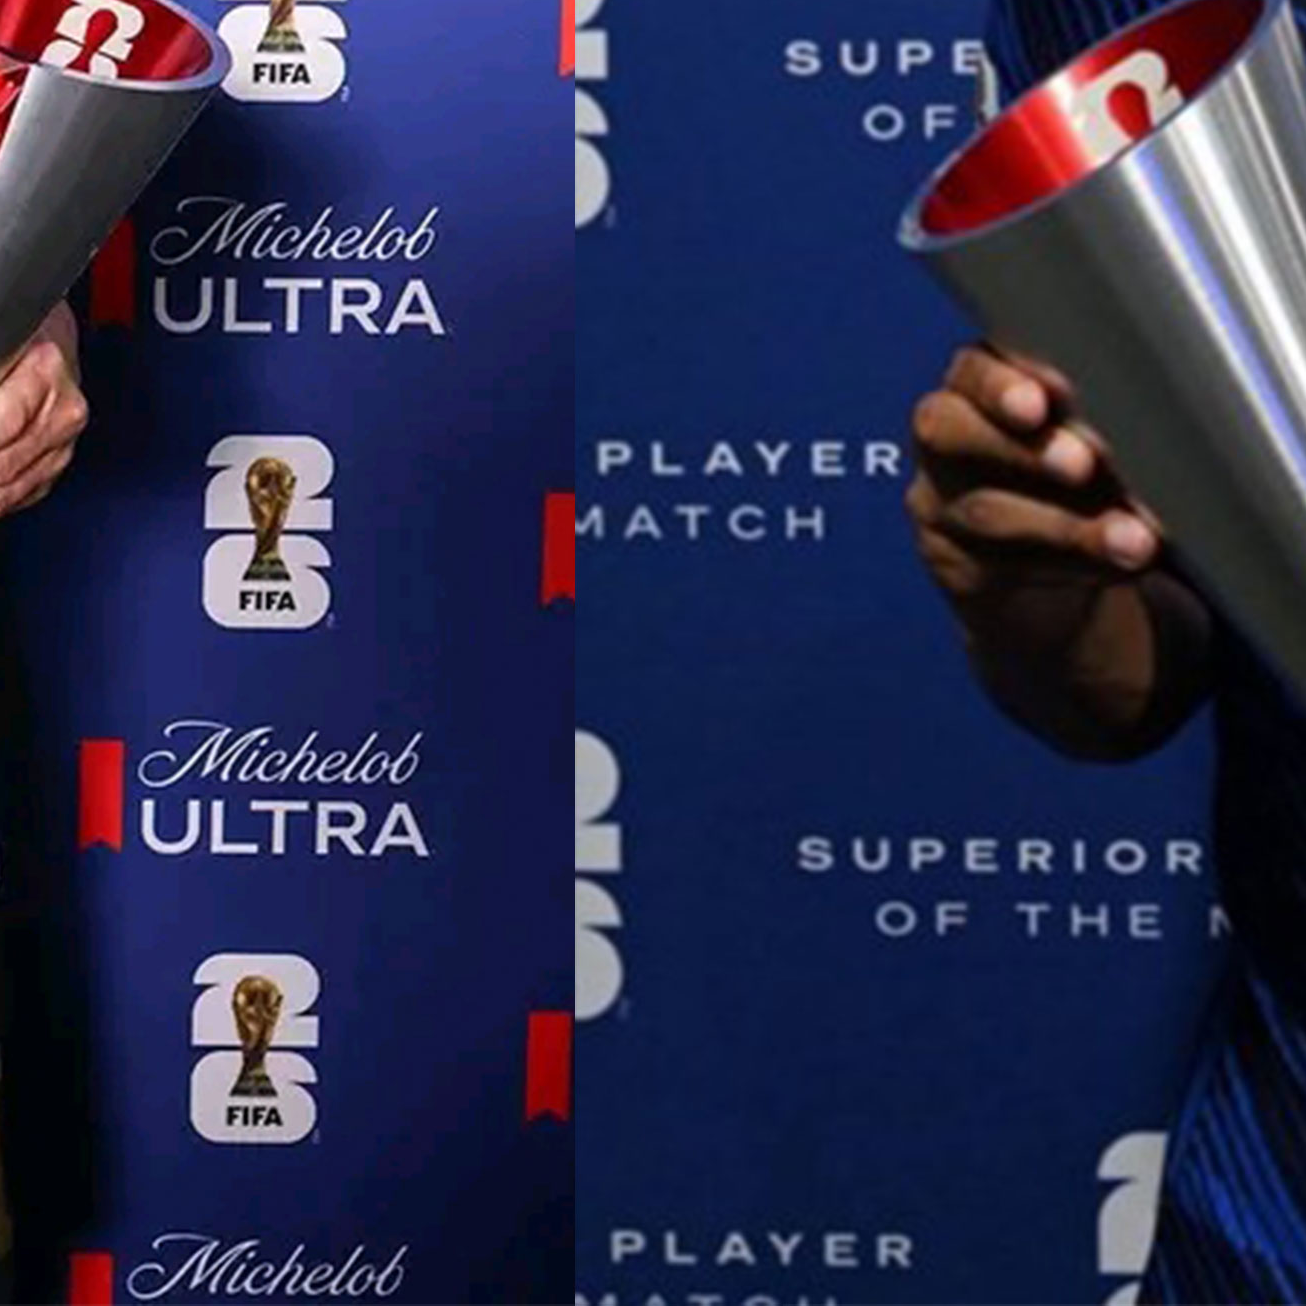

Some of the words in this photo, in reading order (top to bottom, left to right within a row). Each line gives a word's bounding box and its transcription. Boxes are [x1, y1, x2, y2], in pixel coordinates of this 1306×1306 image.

[252, 62, 311, 85] FIFA
[785, 39, 984, 77] SUPE
[862, 104, 956, 141] OF
[149, 195, 439, 266] Michelob
[155, 278, 445, 335] ULTRA
[597, 441, 901, 476] PLAYER
[576, 504, 824, 541] MATCH
[239, 590, 297, 612] FIFA
[137, 720, 423, 788] Michelob
[141, 798, 429, 857] ULTRA
[798, 836, 1202, 875] SUPERIOR
[875, 901, 968, 937] OF
[1015, 902, 1161, 939] THE
[226, 1105, 284, 1127] FIFA
[126, 1233, 408, 1300] Michelob
[610, 1229, 912, 1268] PLAYER
